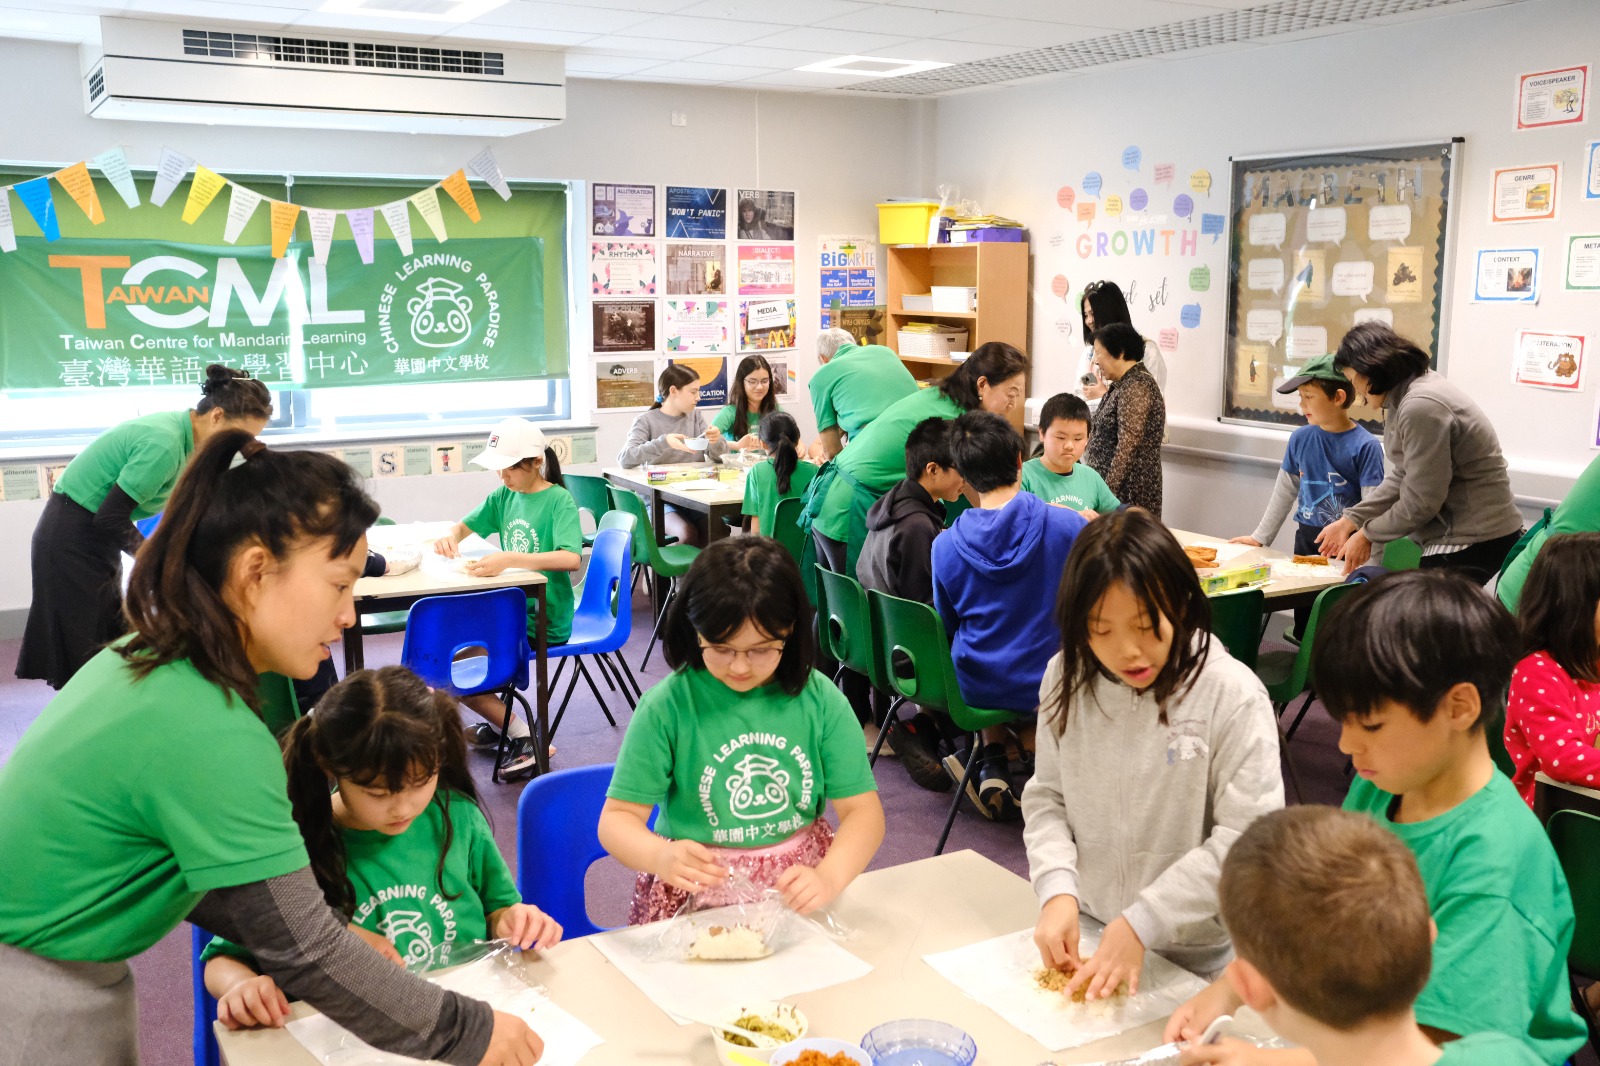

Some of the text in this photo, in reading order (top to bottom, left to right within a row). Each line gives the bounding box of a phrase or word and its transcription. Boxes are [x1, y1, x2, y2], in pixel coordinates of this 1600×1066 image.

[1529, 75, 1576, 87] VOICE/SPEAKER
[1243, 164, 1422, 208] MACBETH
[1514, 174, 1536, 182] GENRE
[738, 190, 760, 199] VERB
[1076, 229, 1197, 259] GROWTH
[48, 254, 366, 328] TCML
[1149, 277, 1169, 312] set
[378, 253, 501, 354] CHINESE LEARNING PARADISE
[757, 306, 778, 315] MEDIA
[59, 334, 125, 350] Taiwan
[130, 334, 188, 349] Centre
[193, 334, 215, 348] for
[394, 353, 490, 375] 華園中文學校
[699, 389, 725, 398] ICATION
[379, 451, 396, 474] S
[1050, 494, 1083, 506] EARNING
[529, 528, 540, 553] PARAD
[699, 732, 814, 827] CHINESE LEARNING PARADISE
[352, 884, 457, 965] LEARNING PARADISE
